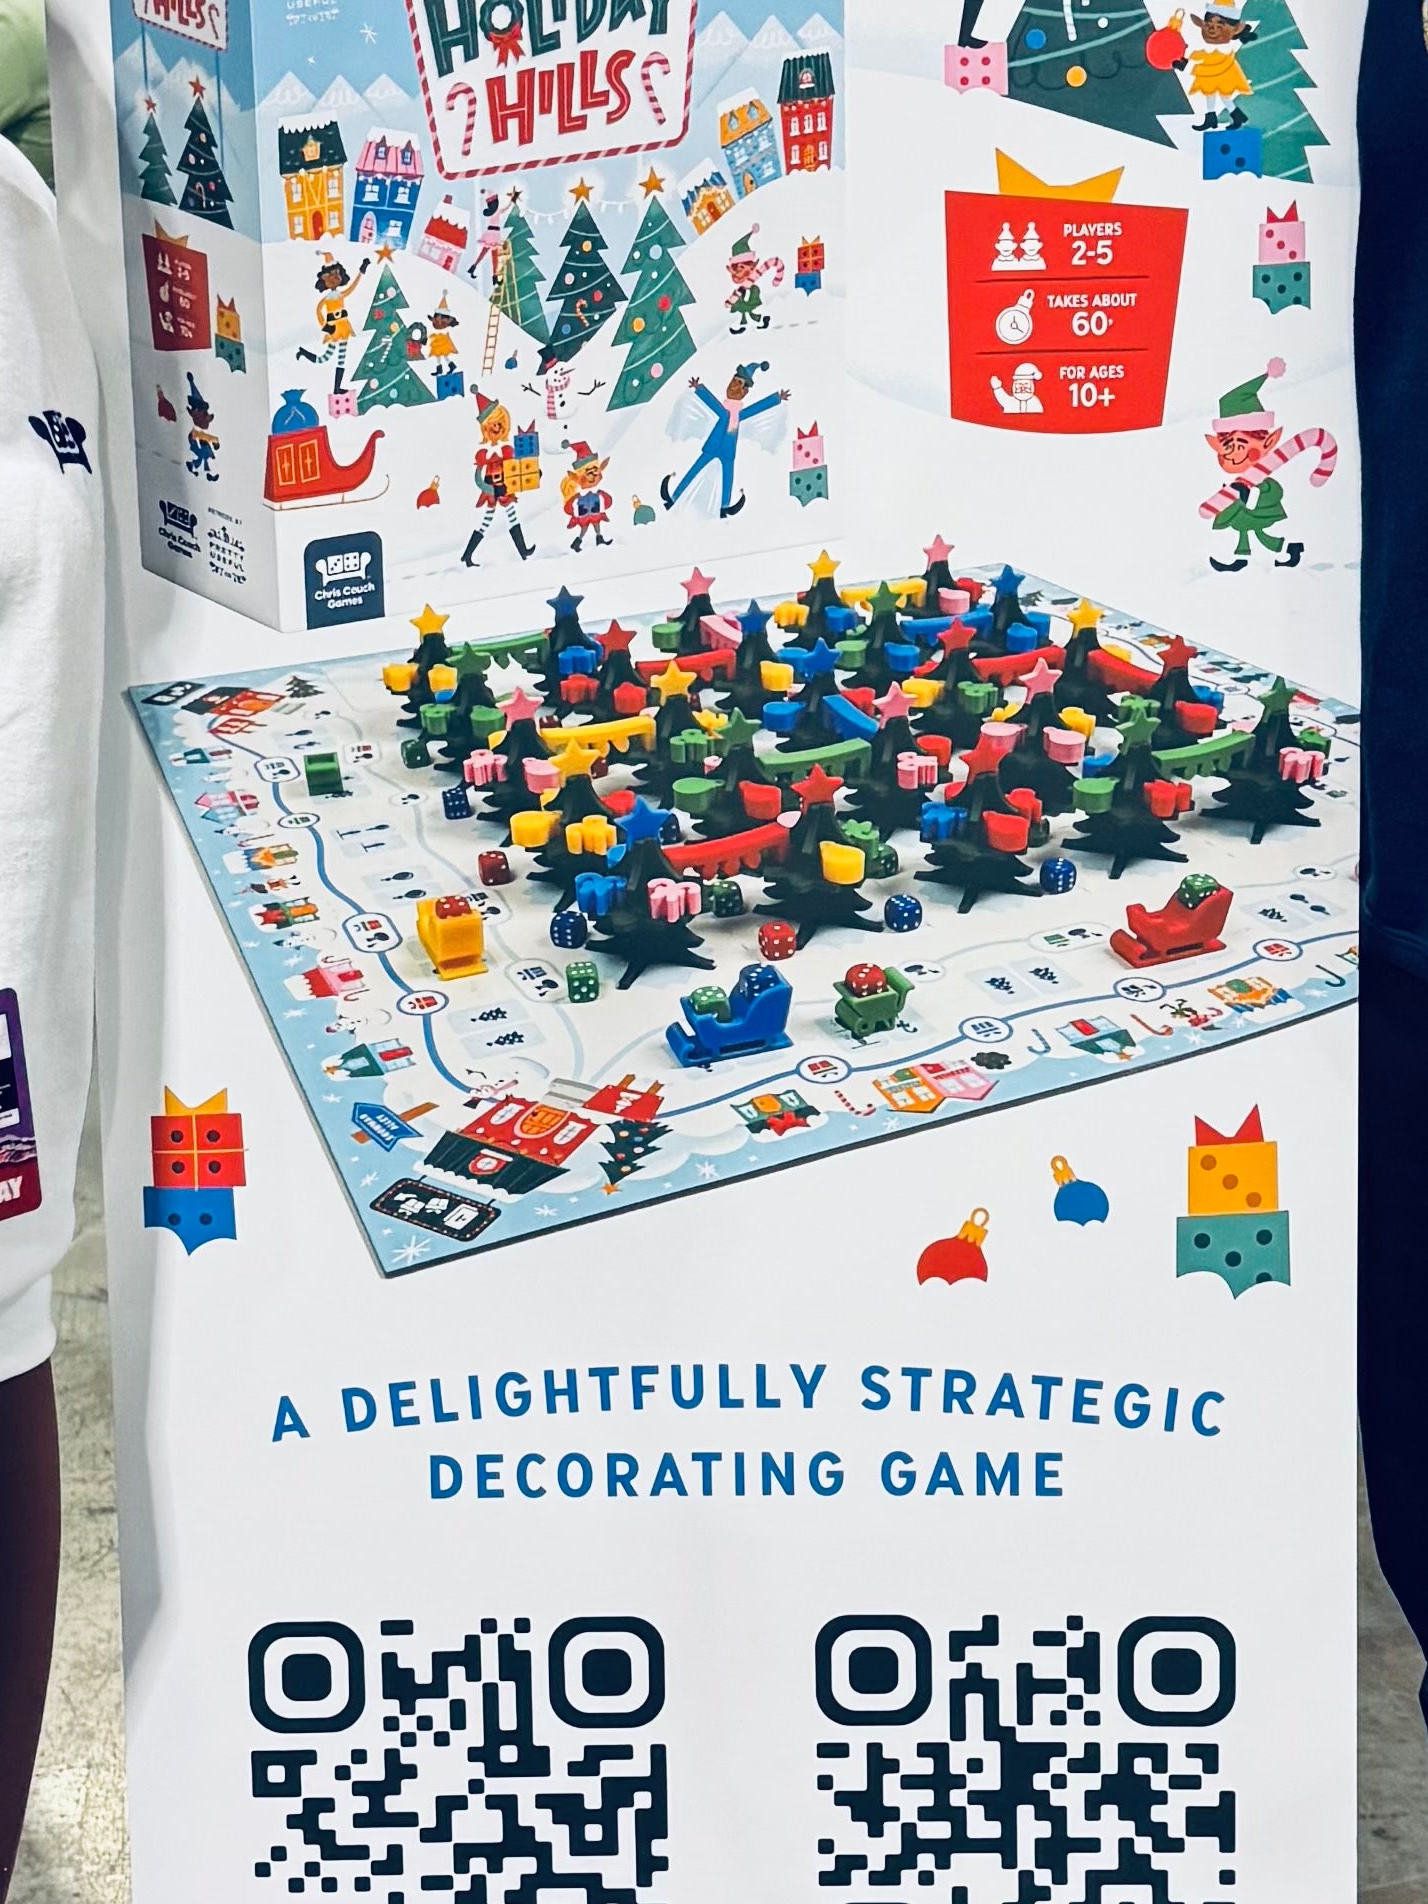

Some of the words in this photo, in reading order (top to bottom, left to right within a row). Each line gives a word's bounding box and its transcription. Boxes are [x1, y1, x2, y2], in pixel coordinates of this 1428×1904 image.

[485, 49, 637, 146] HILLS
[1063, 222, 1123, 237] PLAYERS
[1071, 240, 1113, 266] 2-5
[1047, 294, 1088, 308] TAKES
[1092, 293, 1138, 307] ABOUT
[1059, 366, 1085, 380] FOR
[1089, 365, 1125, 379] AGES
[1068, 382, 1115, 408] 10+
[314, 587, 341, 601] Chris
[342, 582, 375, 596] Couch
[327, 596, 363, 609] Games
[272, 1396, 309, 1442] A
[341, 1363, 825, 1434] DELIGHTFULLY
[860, 1365, 1224, 1438] STRATEGIC
[429, 1451, 844, 1500] DECORATING
[880, 1451, 1063, 1498] GAME
